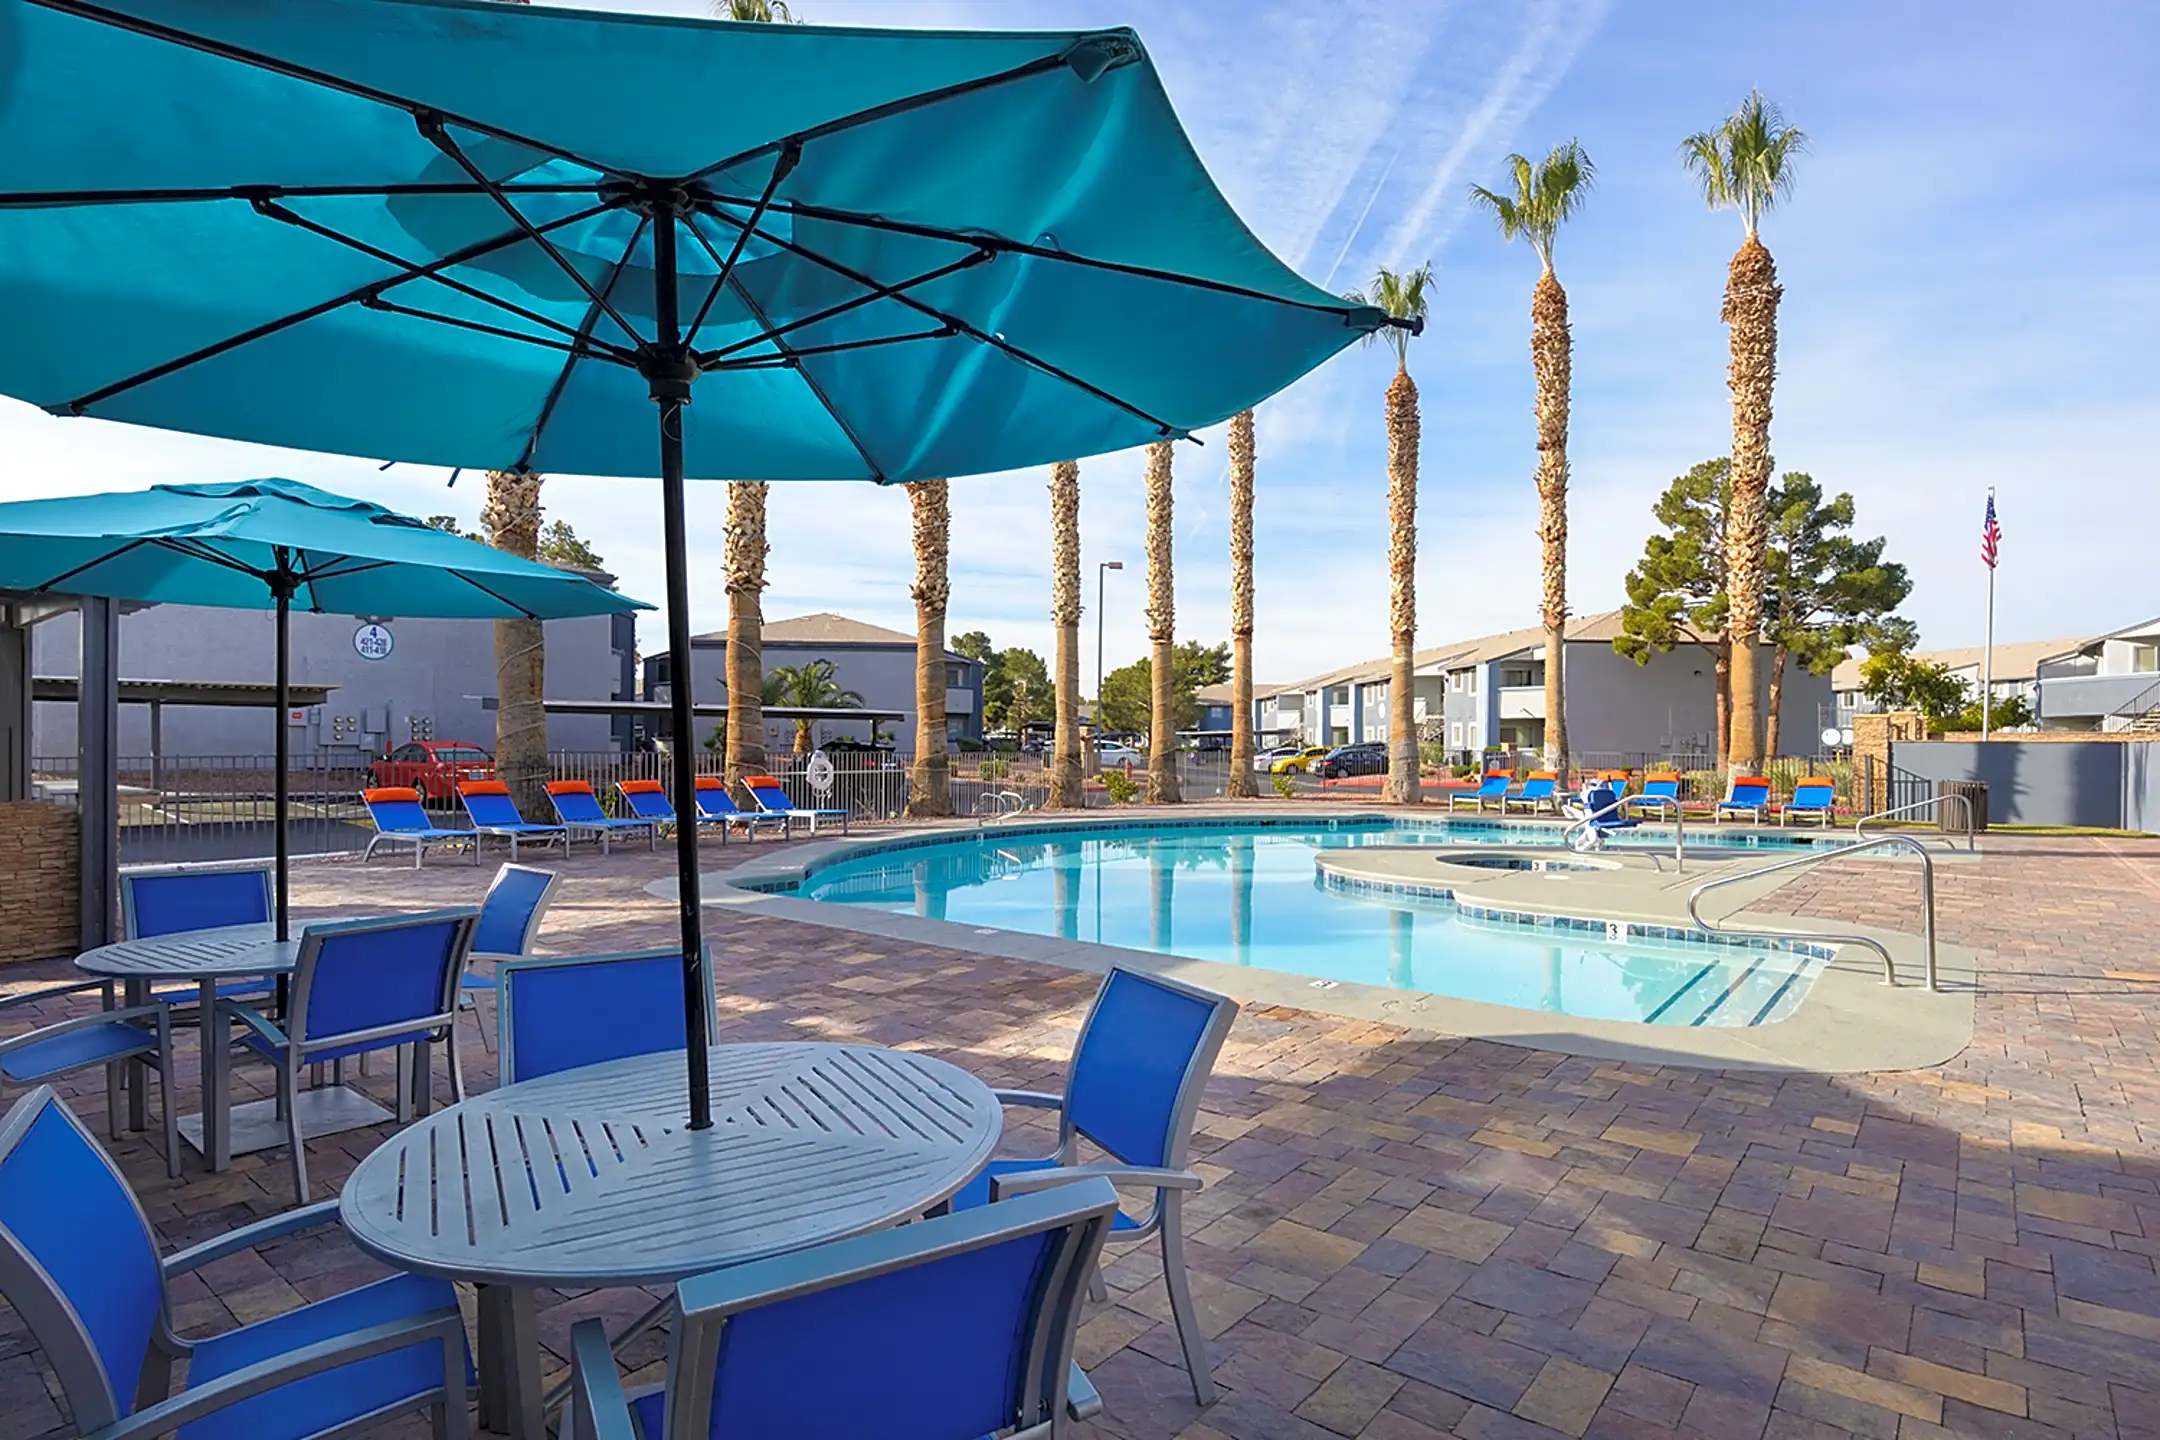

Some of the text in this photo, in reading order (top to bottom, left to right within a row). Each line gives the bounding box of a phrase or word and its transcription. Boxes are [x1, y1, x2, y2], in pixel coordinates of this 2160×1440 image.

[370, 626, 377, 638] 4
[1534, 862, 1540, 871] 3
[1609, 923, 1618, 934] 3
